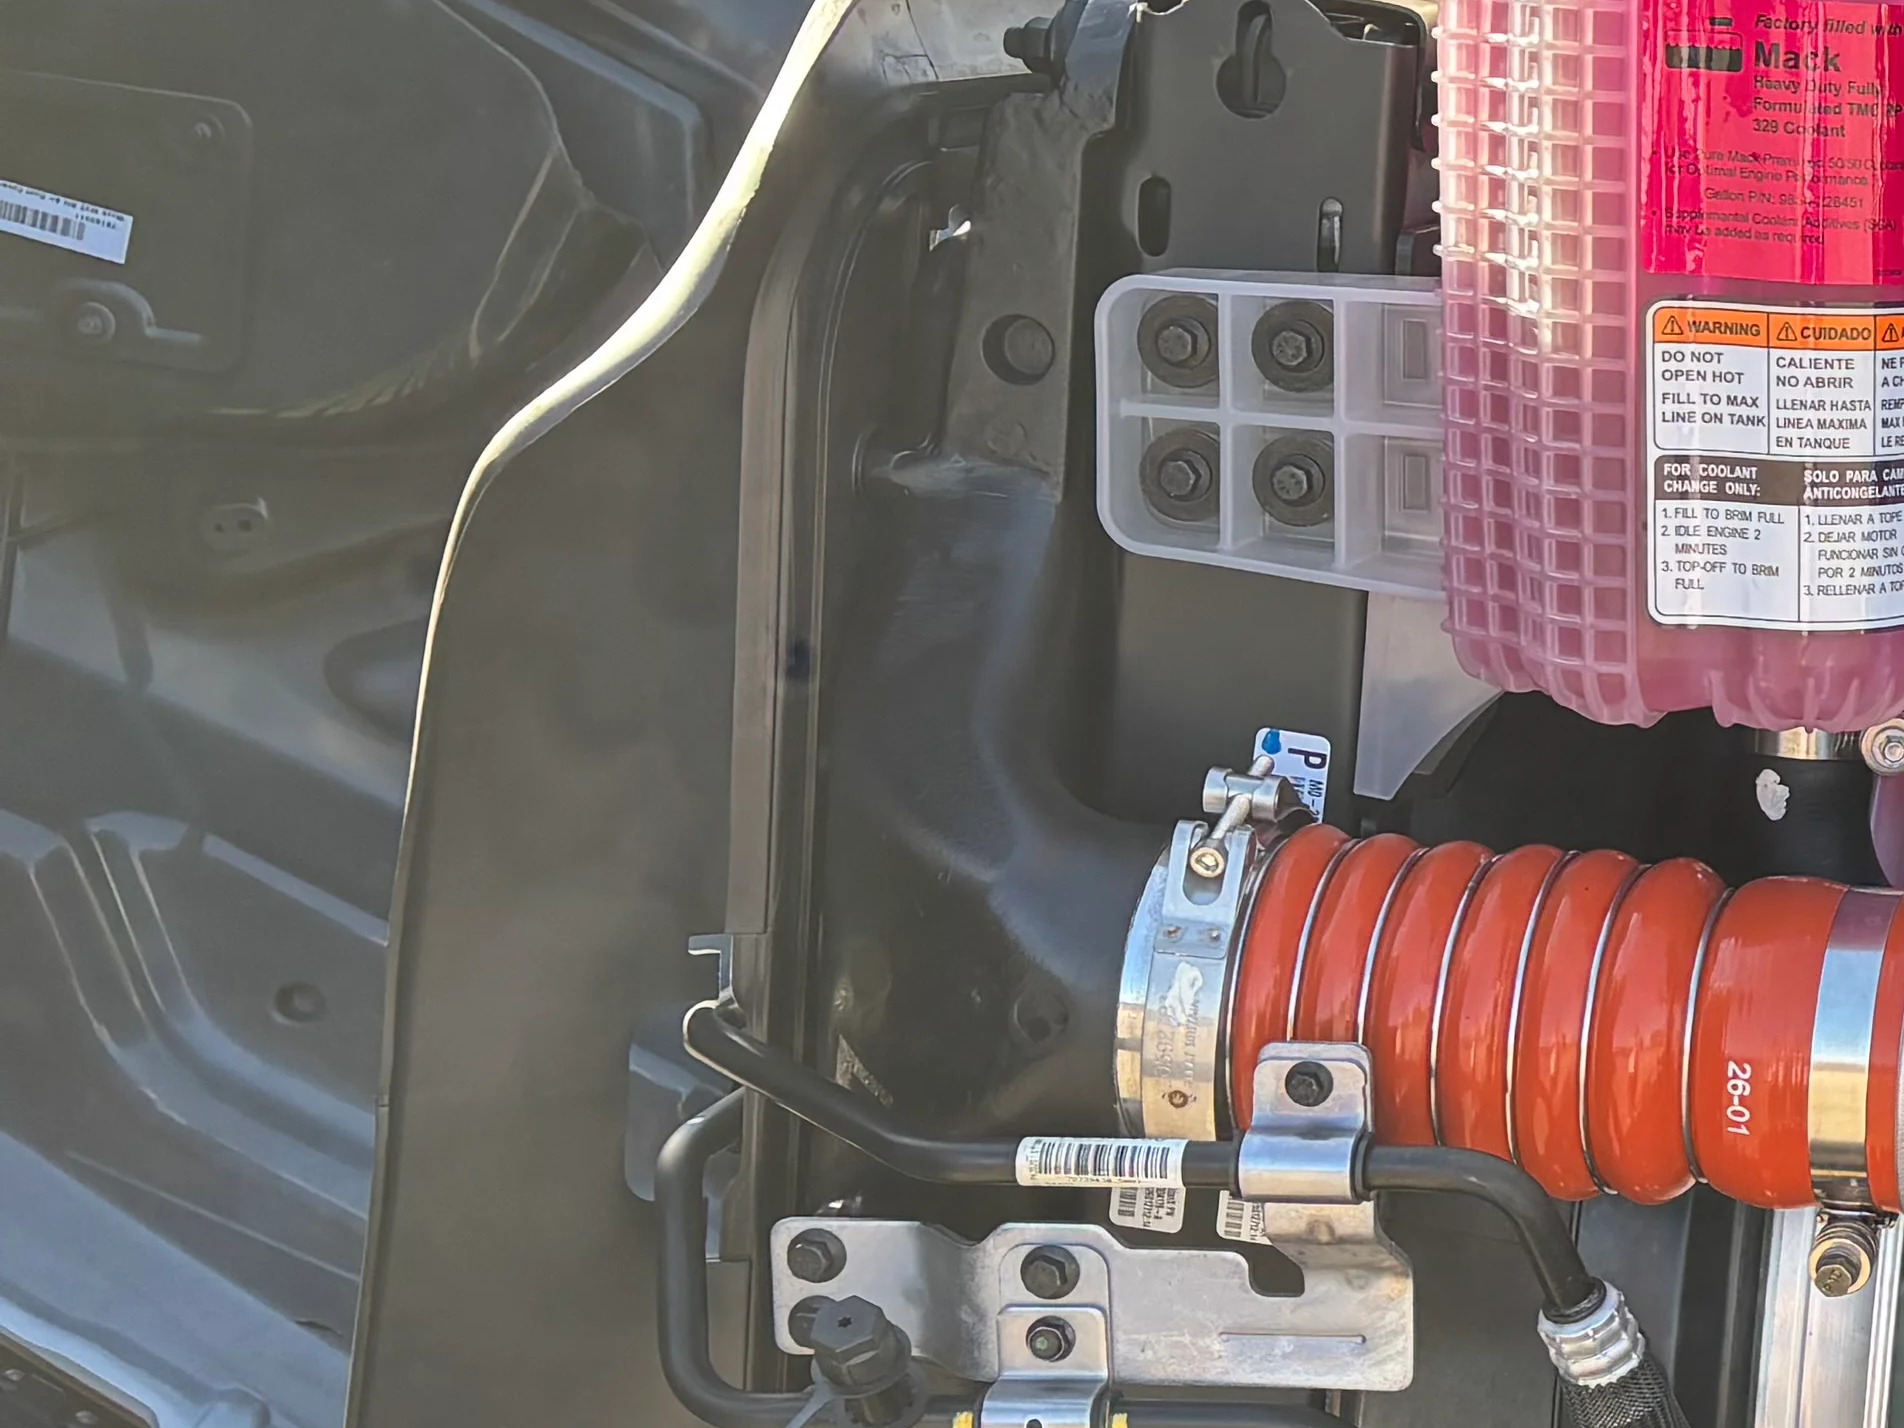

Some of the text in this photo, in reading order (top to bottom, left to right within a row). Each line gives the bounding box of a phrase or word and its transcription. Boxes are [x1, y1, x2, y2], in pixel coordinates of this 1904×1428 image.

[1755, 40, 1841, 72] Mack
[1688, 320, 1871, 340] WARNING CUIDADO
[1662, 352, 1724, 364] DO NOT
[1776, 357, 1854, 369] CALIENTE
[1662, 370, 1744, 384] OPEN HOT
[1776, 376, 1853, 388] NO ABRIR
[1662, 393, 1759, 408] FILL TO MAX
[1776, 399, 1826, 411] LLENAR
[1831, 400, 1871, 411] HASTA
[1662, 412, 1766, 427] LINE ON TANK
[1776, 418, 1867, 430] LINEA MAXIMA
[1776, 437, 1850, 449] EN TANQUE
[1664, 463, 1757, 479] FOR COOLANT
[1804, 470, 1877, 483] SOLO PARA
[1664, 480, 1760, 496] CHANGE ONLY:
[1675, 508, 1784, 524] FILL TO BRIM FULL
[1867, 514, 1874, 524] A
[1675, 526, 1761, 540] IDLE ENGINE 2
[1818, 532, 1855, 543] DEJAR
[1675, 544, 1727, 555] MINUTES
[1732, 563, 1747, 574] TO
[1752, 565, 1779, 577] BRIM
[1818, 567, 1842, 578] POR
[1849, 567, 1855, 578] 2
[1675, 578, 1704, 590] FULL
[1880, 583, 1886, 594] A
[1288, 748, 1327, 769] P
[1726, 1060, 1751, 1135] 26-01
